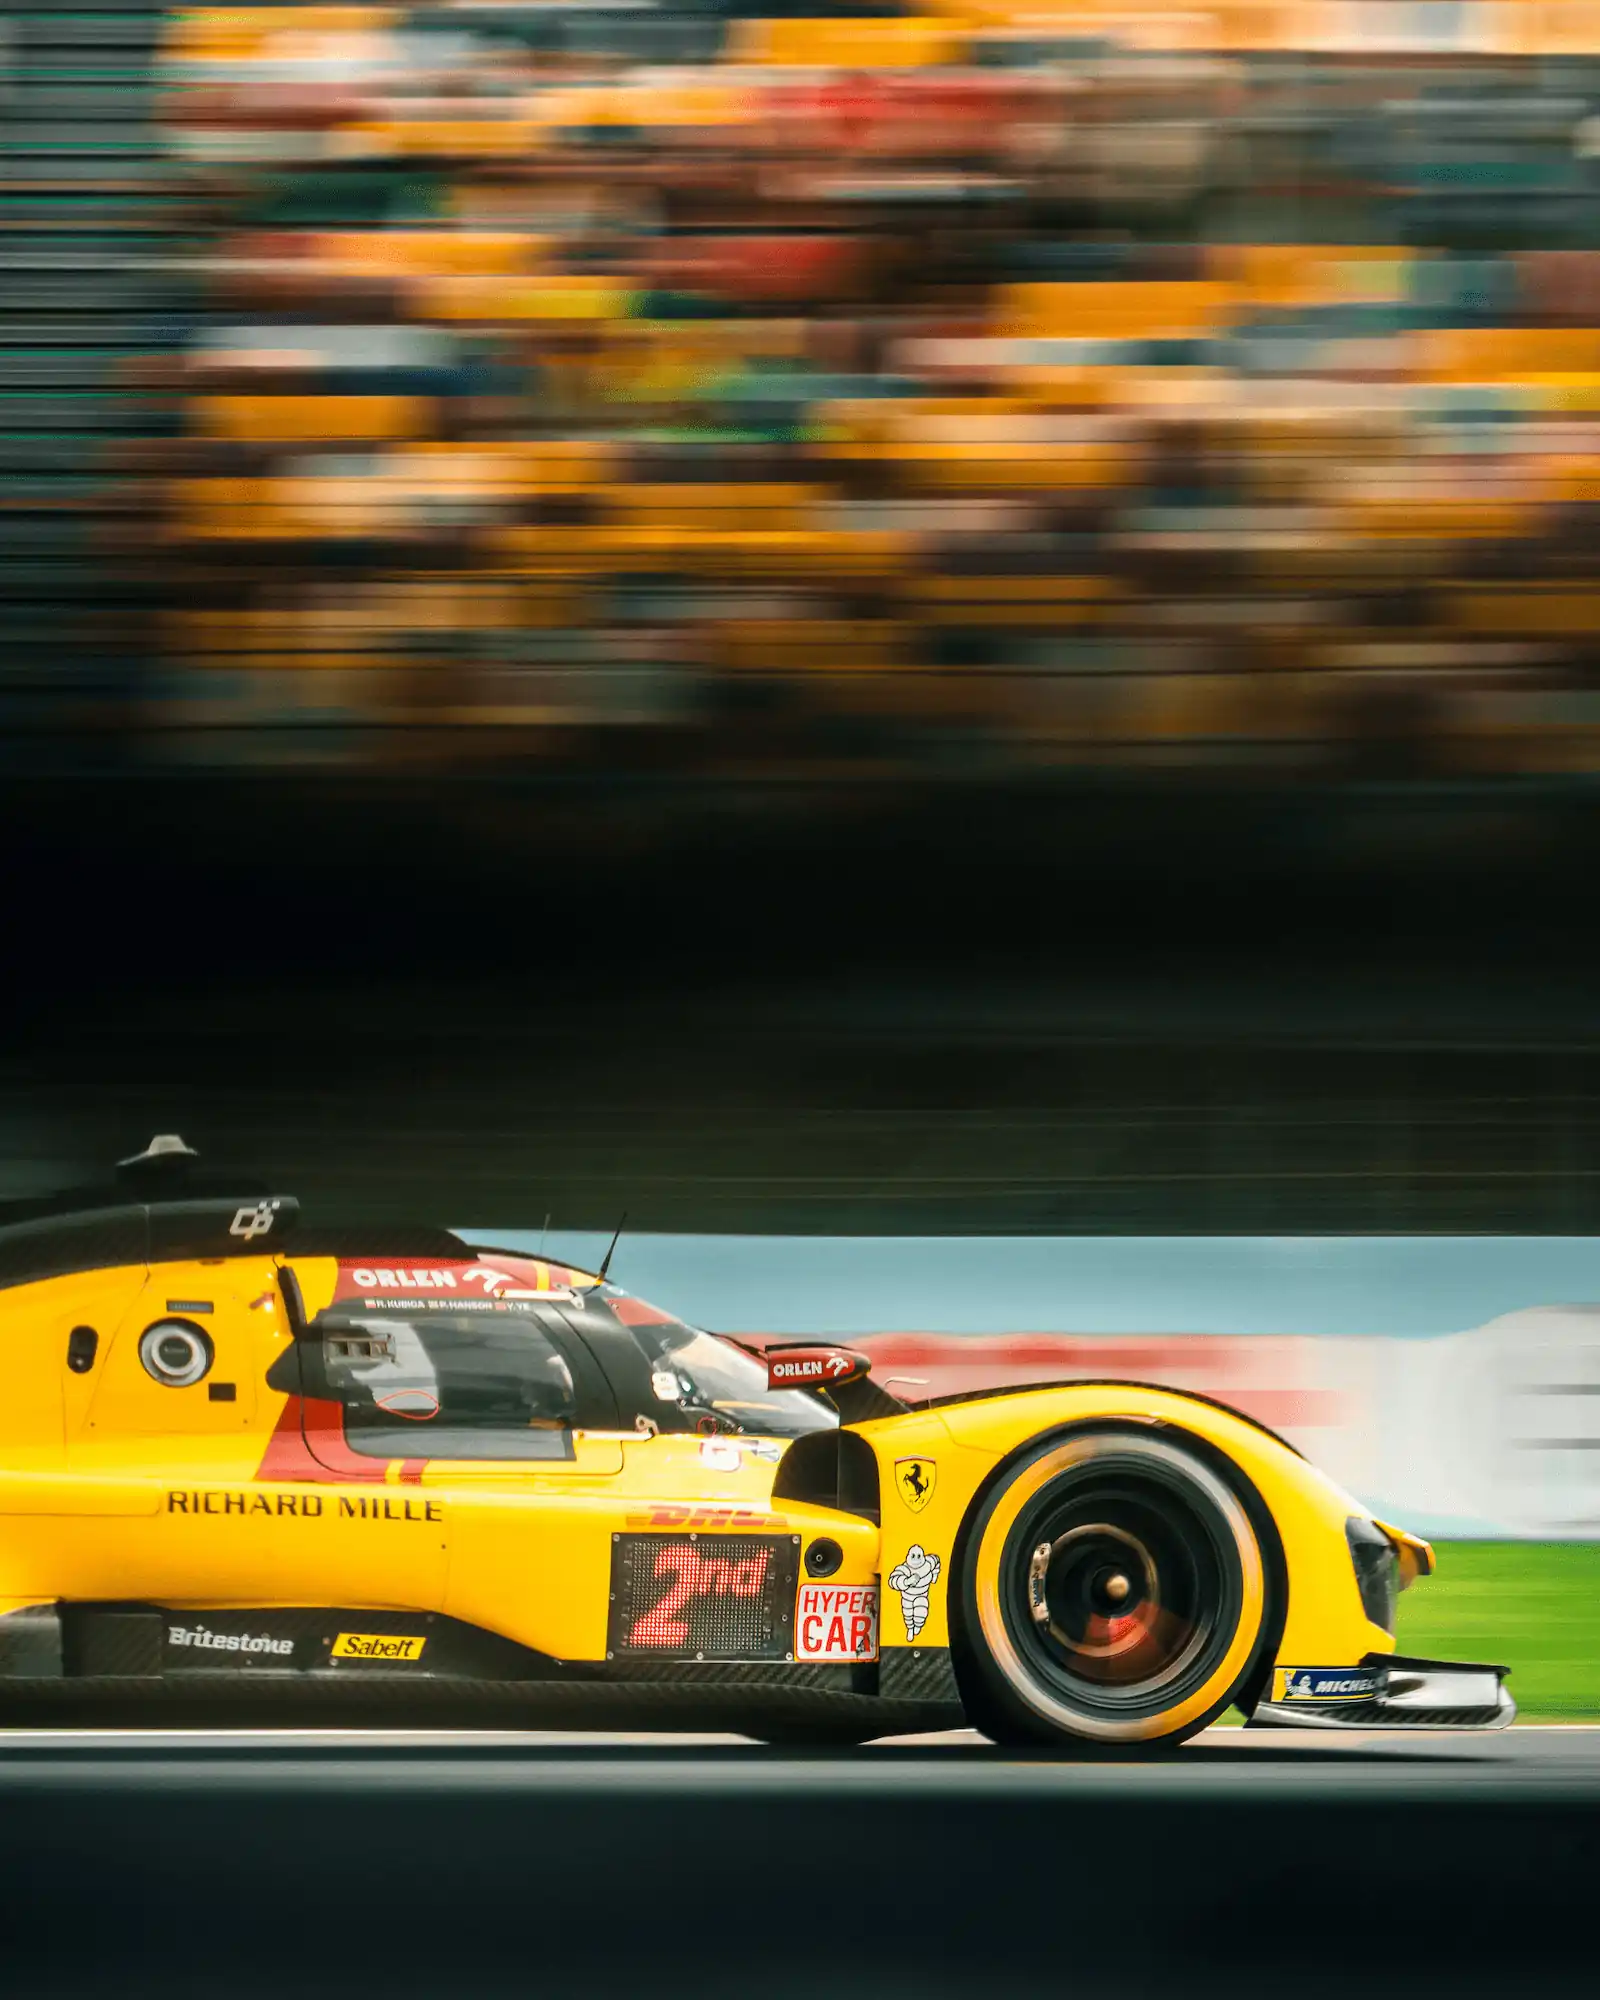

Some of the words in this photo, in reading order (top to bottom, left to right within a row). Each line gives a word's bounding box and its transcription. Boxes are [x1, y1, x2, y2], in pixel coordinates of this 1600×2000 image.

[353, 1268, 457, 1288] ORLEN
[773, 1361, 823, 1377] ORLEN
[168, 1490, 323, 1517] RICHARD
[339, 1496, 443, 1522] MILLE
[648, 1505, 767, 1527] DHL
[630, 1546, 769, 1645] 2nd
[803, 1591, 876, 1614] HYPER
[168, 1624, 294, 1655] Britestone
[802, 1615, 873, 1653] CAR
[343, 1636, 415, 1658] Sabelt
